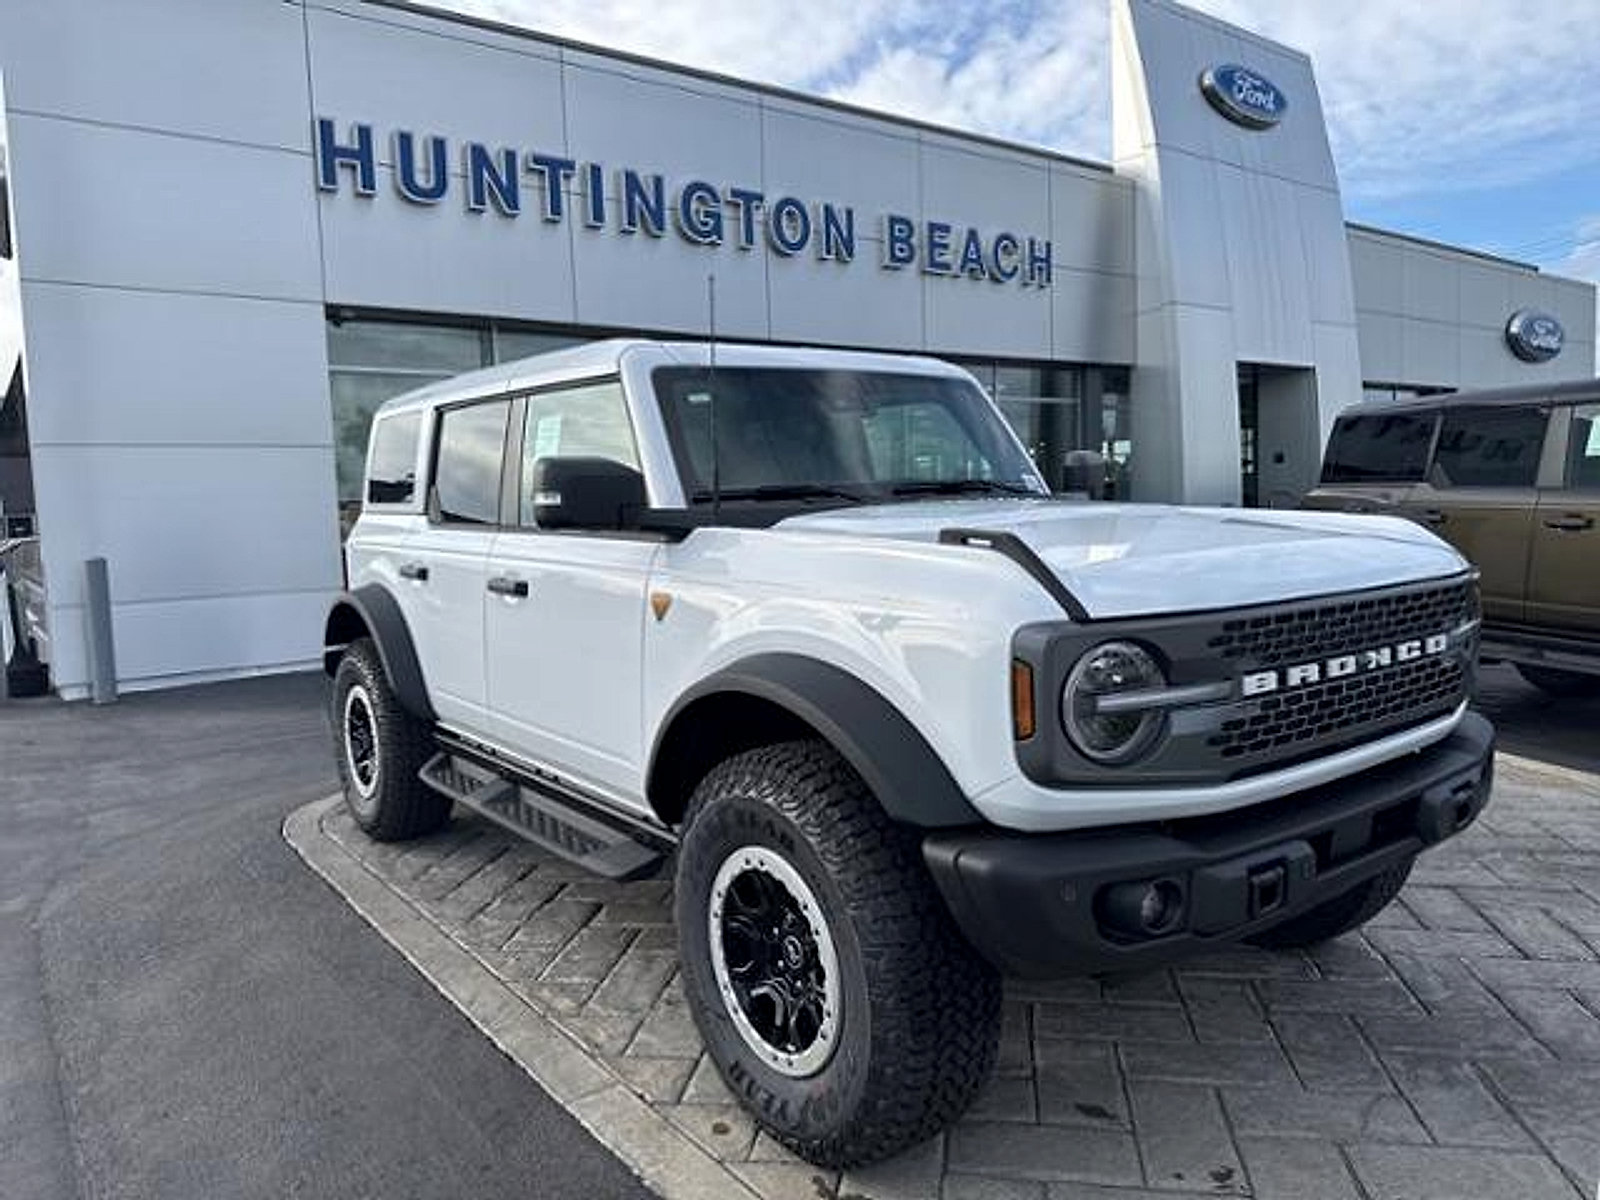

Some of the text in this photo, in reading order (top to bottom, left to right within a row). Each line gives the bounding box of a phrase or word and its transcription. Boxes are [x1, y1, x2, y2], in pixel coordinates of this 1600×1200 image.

[1231, 72, 1275, 113] Ford
[318, 118, 1054, 288] HUNTINGTON BEACH
[1241, 634, 1448, 696] BRONCO
